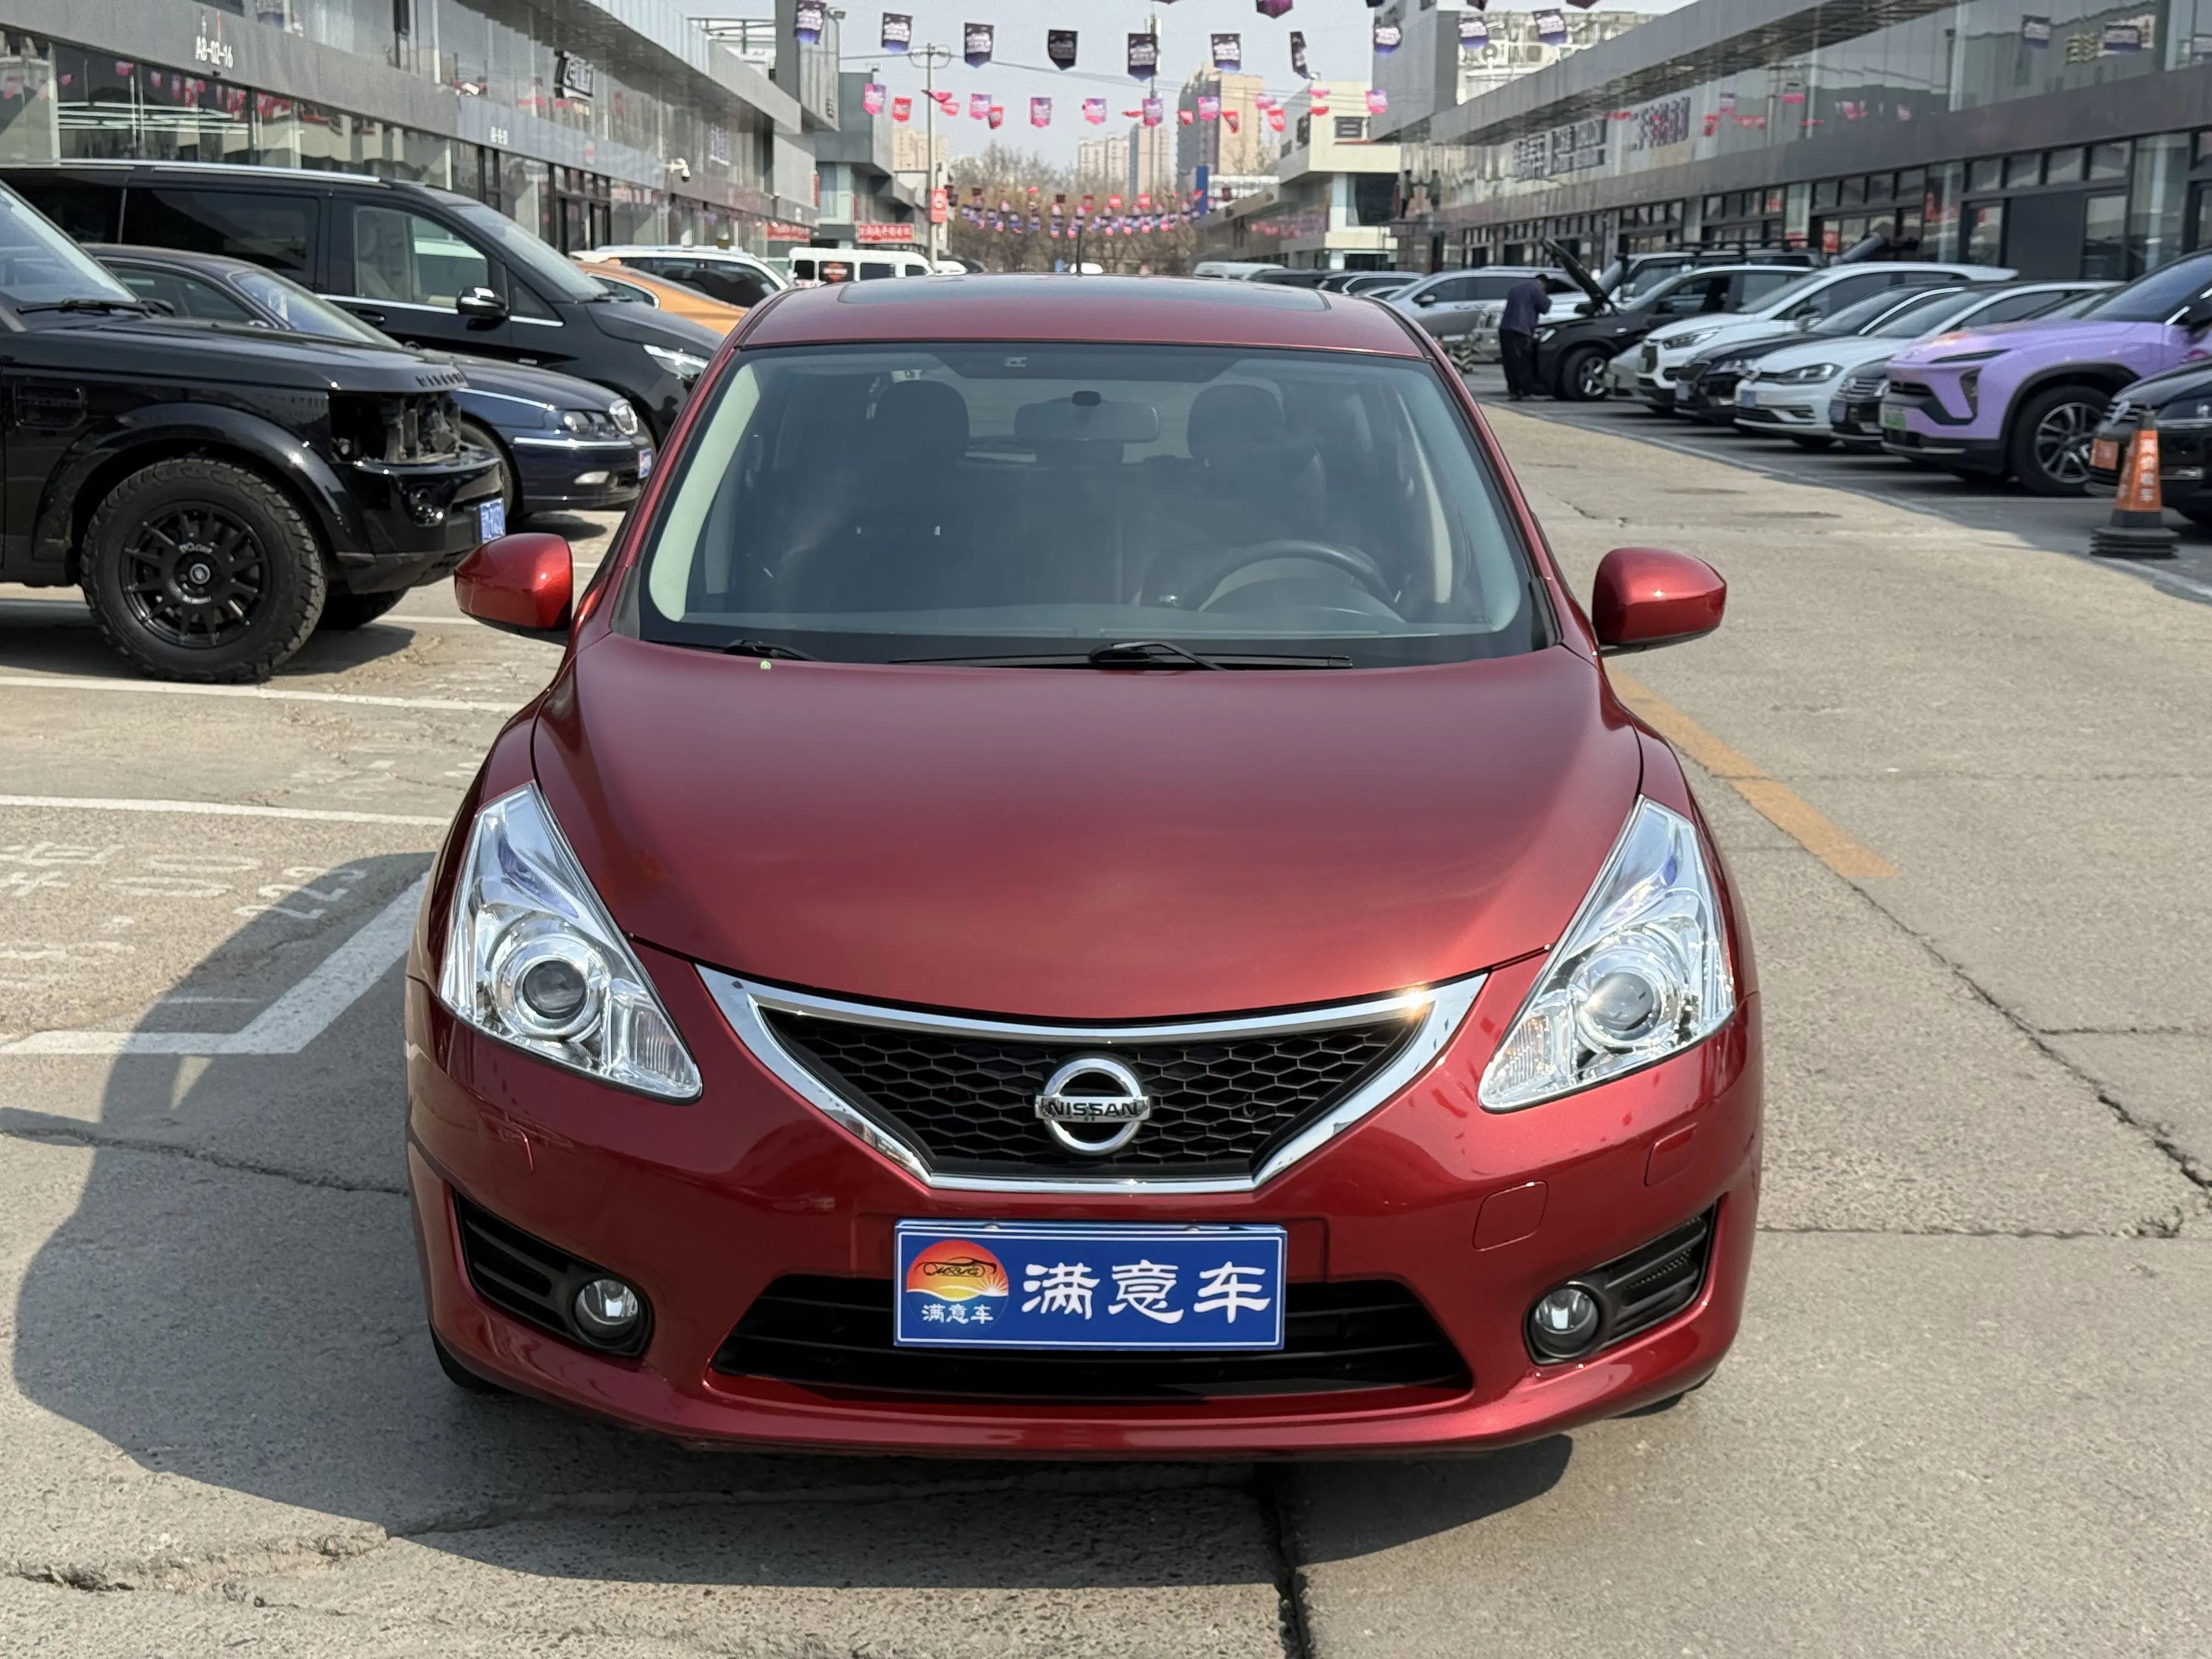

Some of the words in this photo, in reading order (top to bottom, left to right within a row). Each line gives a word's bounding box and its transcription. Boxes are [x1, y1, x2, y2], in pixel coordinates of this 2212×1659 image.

[1047, 1102, 1139, 1117] NISSAN
[1021, 1259, 1272, 1324] 满意车
[922, 1304, 994, 1324] 满意车
